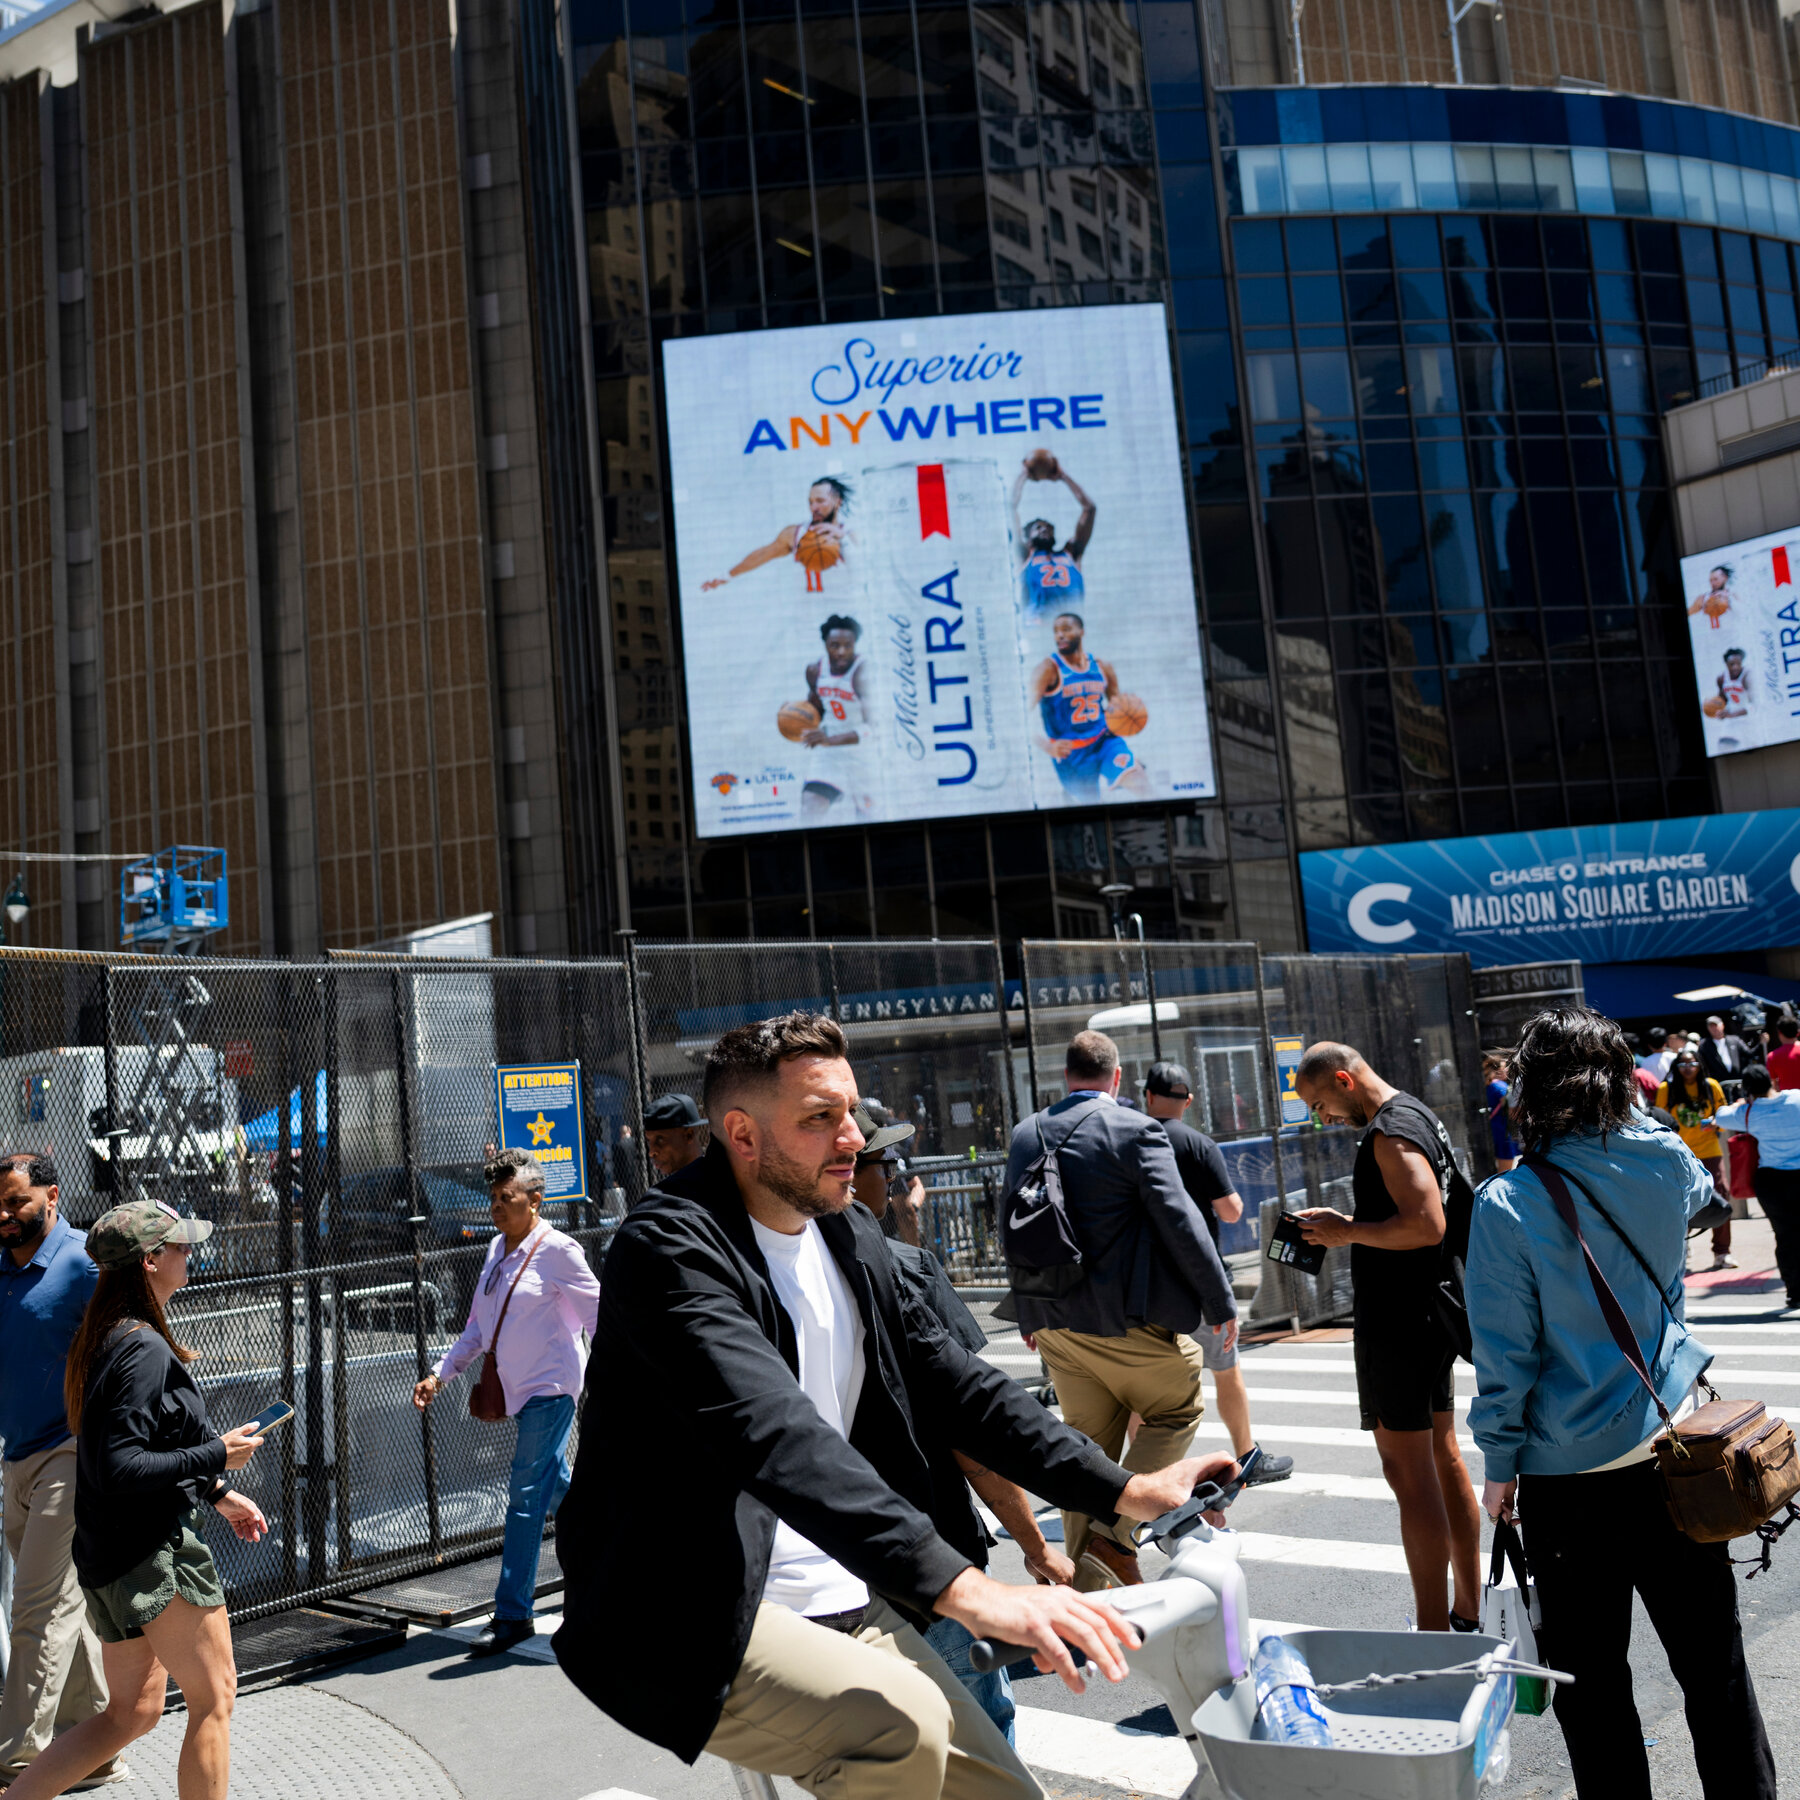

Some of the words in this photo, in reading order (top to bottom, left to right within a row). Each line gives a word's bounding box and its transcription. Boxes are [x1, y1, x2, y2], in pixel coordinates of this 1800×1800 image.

[811, 338, 1022, 405] Superior
[744, 394, 1107, 454] ANYWHERE
[1040, 564, 1071, 588] 23
[888, 613, 925, 761] Michelob
[921, 568, 977, 787] ULTRA
[1070, 694, 1101, 724] 25
[755, 773, 796, 784] ULTRA
[1490, 865, 1557, 886] CHASE
[1584, 852, 1707, 878] ENTRANCE
[1451, 890, 1557, 930] MADISON
[1562, 883, 1653, 921] SQUARE
[1656, 873, 1749, 911] GARDEN
[1498, 927, 1521, 936] THE
[1525, 921, 1577, 934] WORLD'S
[1581, 919, 1612, 929] MOST
[1617, 914, 1664, 926] FAMOUS
[504, 1073, 573, 1088] ATTENTION:
